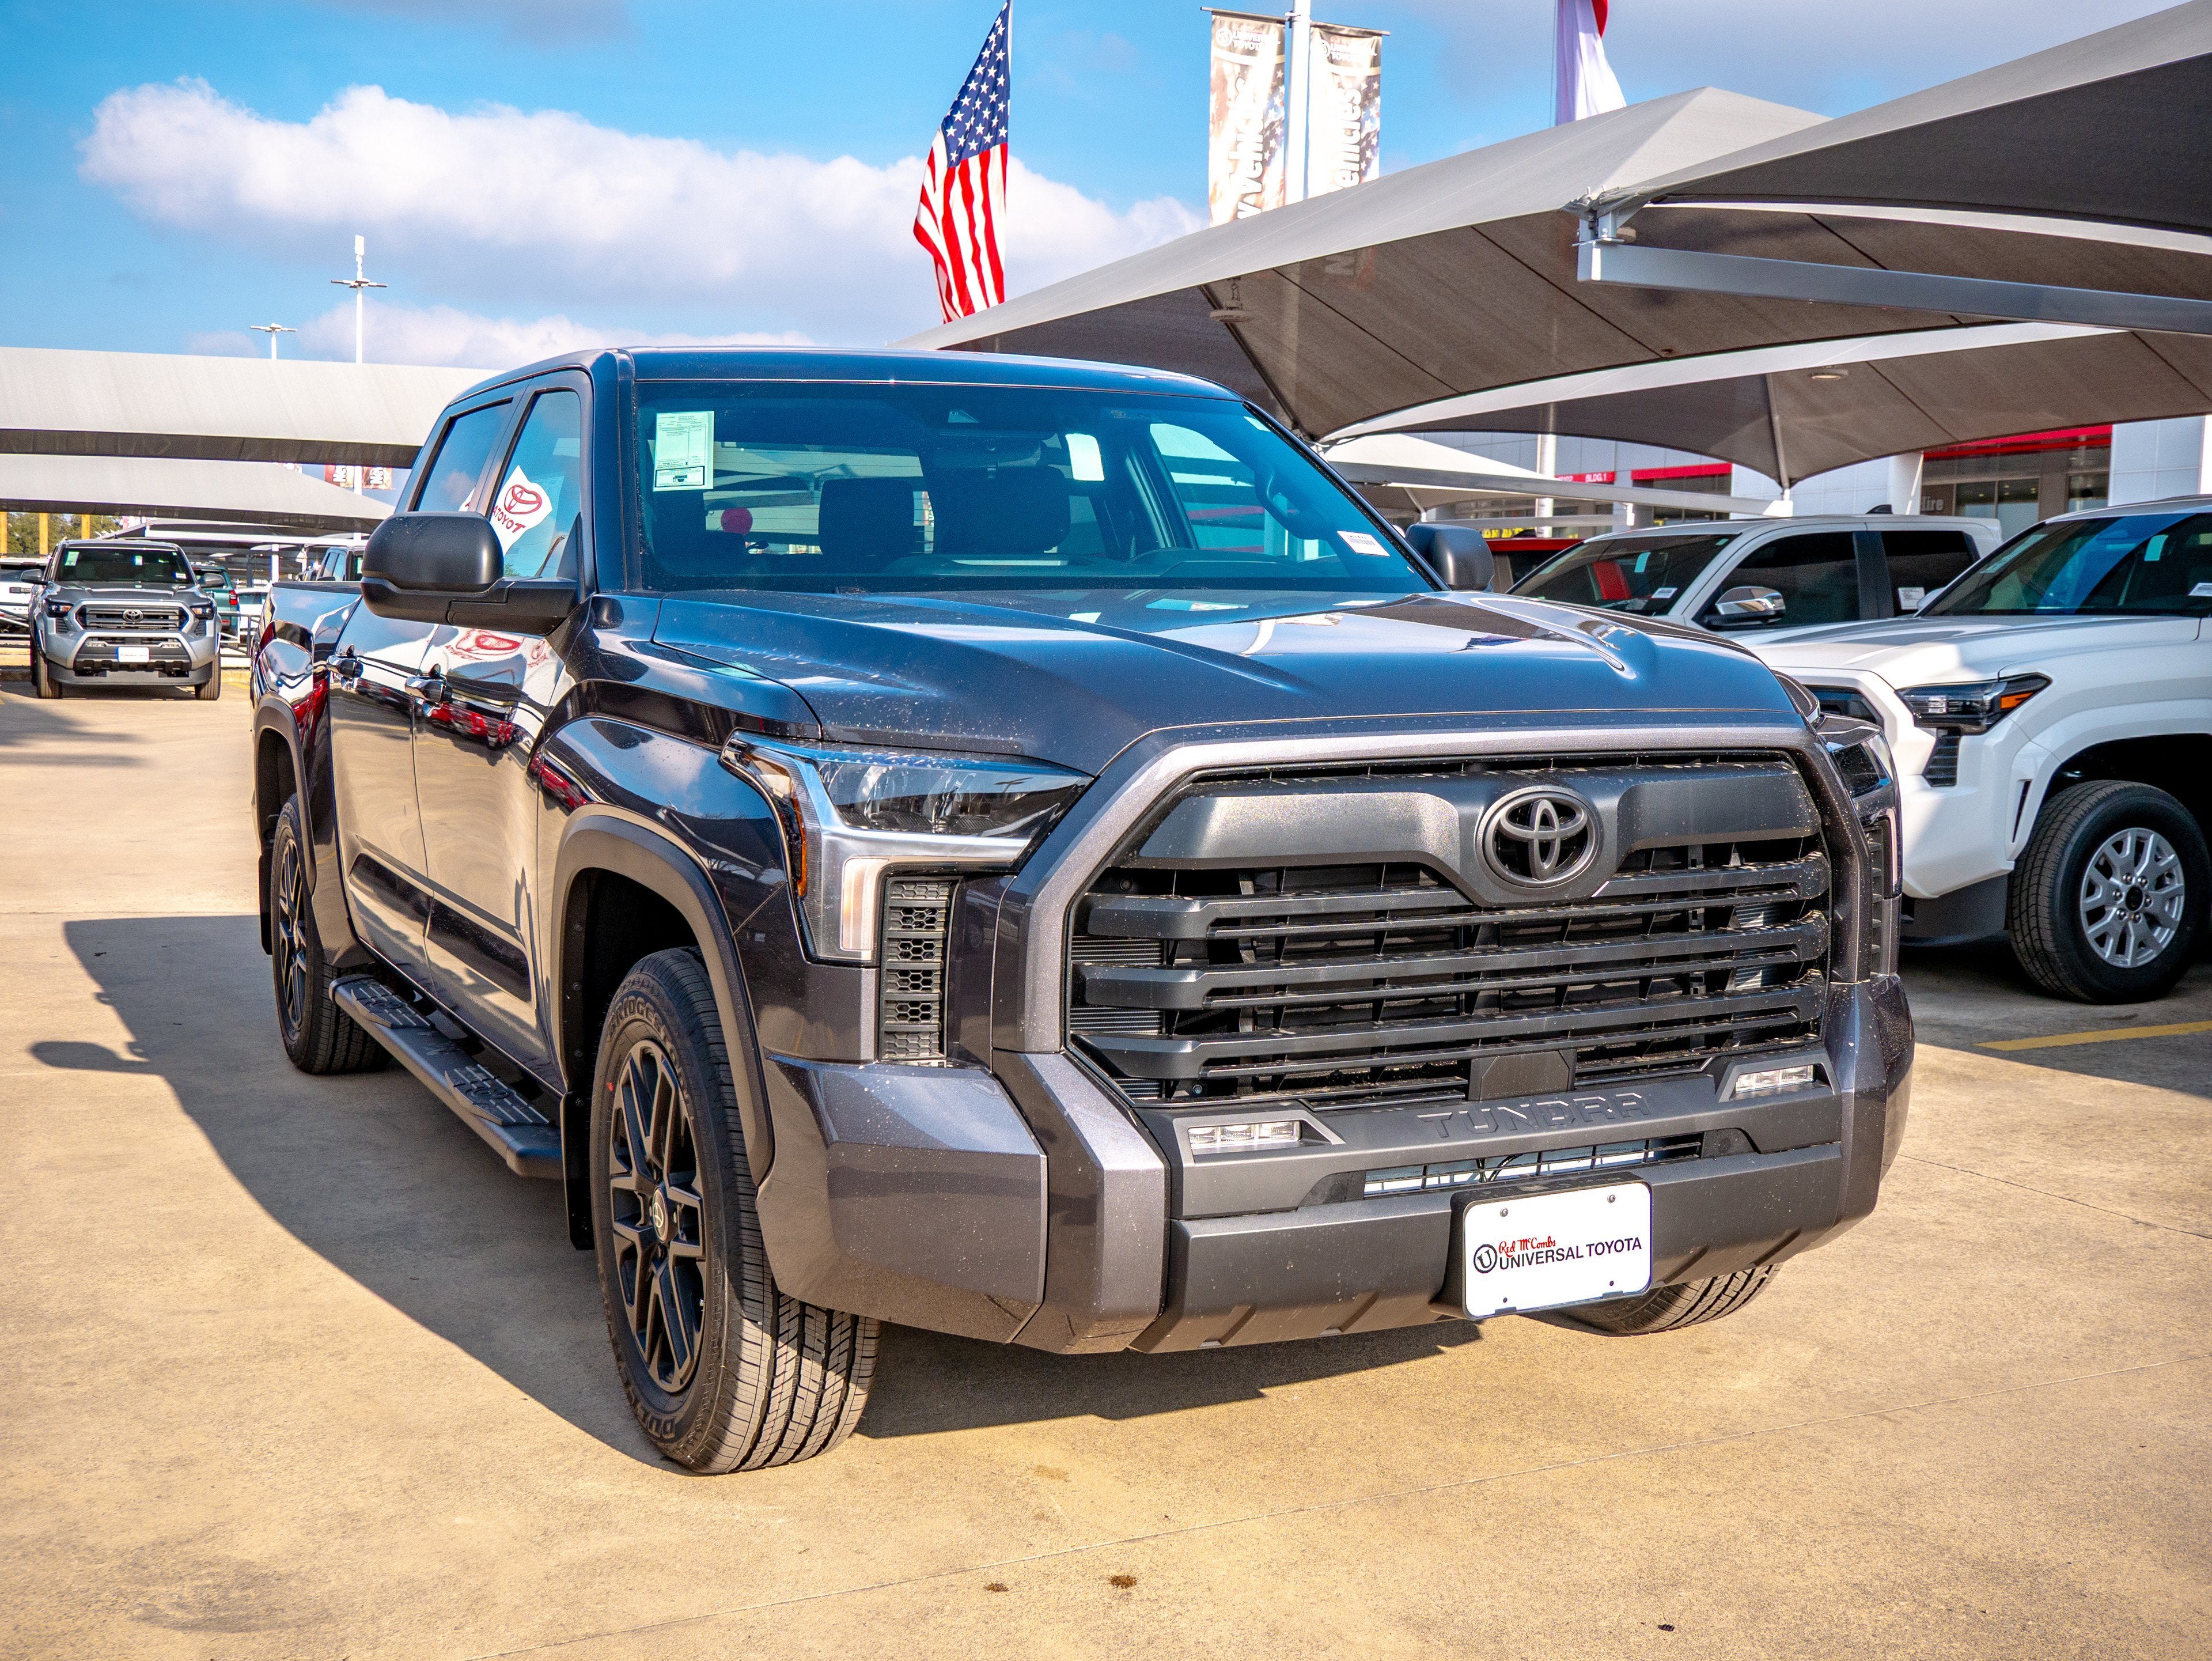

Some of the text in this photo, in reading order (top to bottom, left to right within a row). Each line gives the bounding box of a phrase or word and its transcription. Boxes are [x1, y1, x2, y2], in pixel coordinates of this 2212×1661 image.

[1416, 1092, 1650, 1138] TUNDRA
[1499, 1241, 1516, 1258] Red
[1499, 1245, 1584, 1270] UNIVERSAL
[1586, 1237, 1642, 1257] TOYOTA
